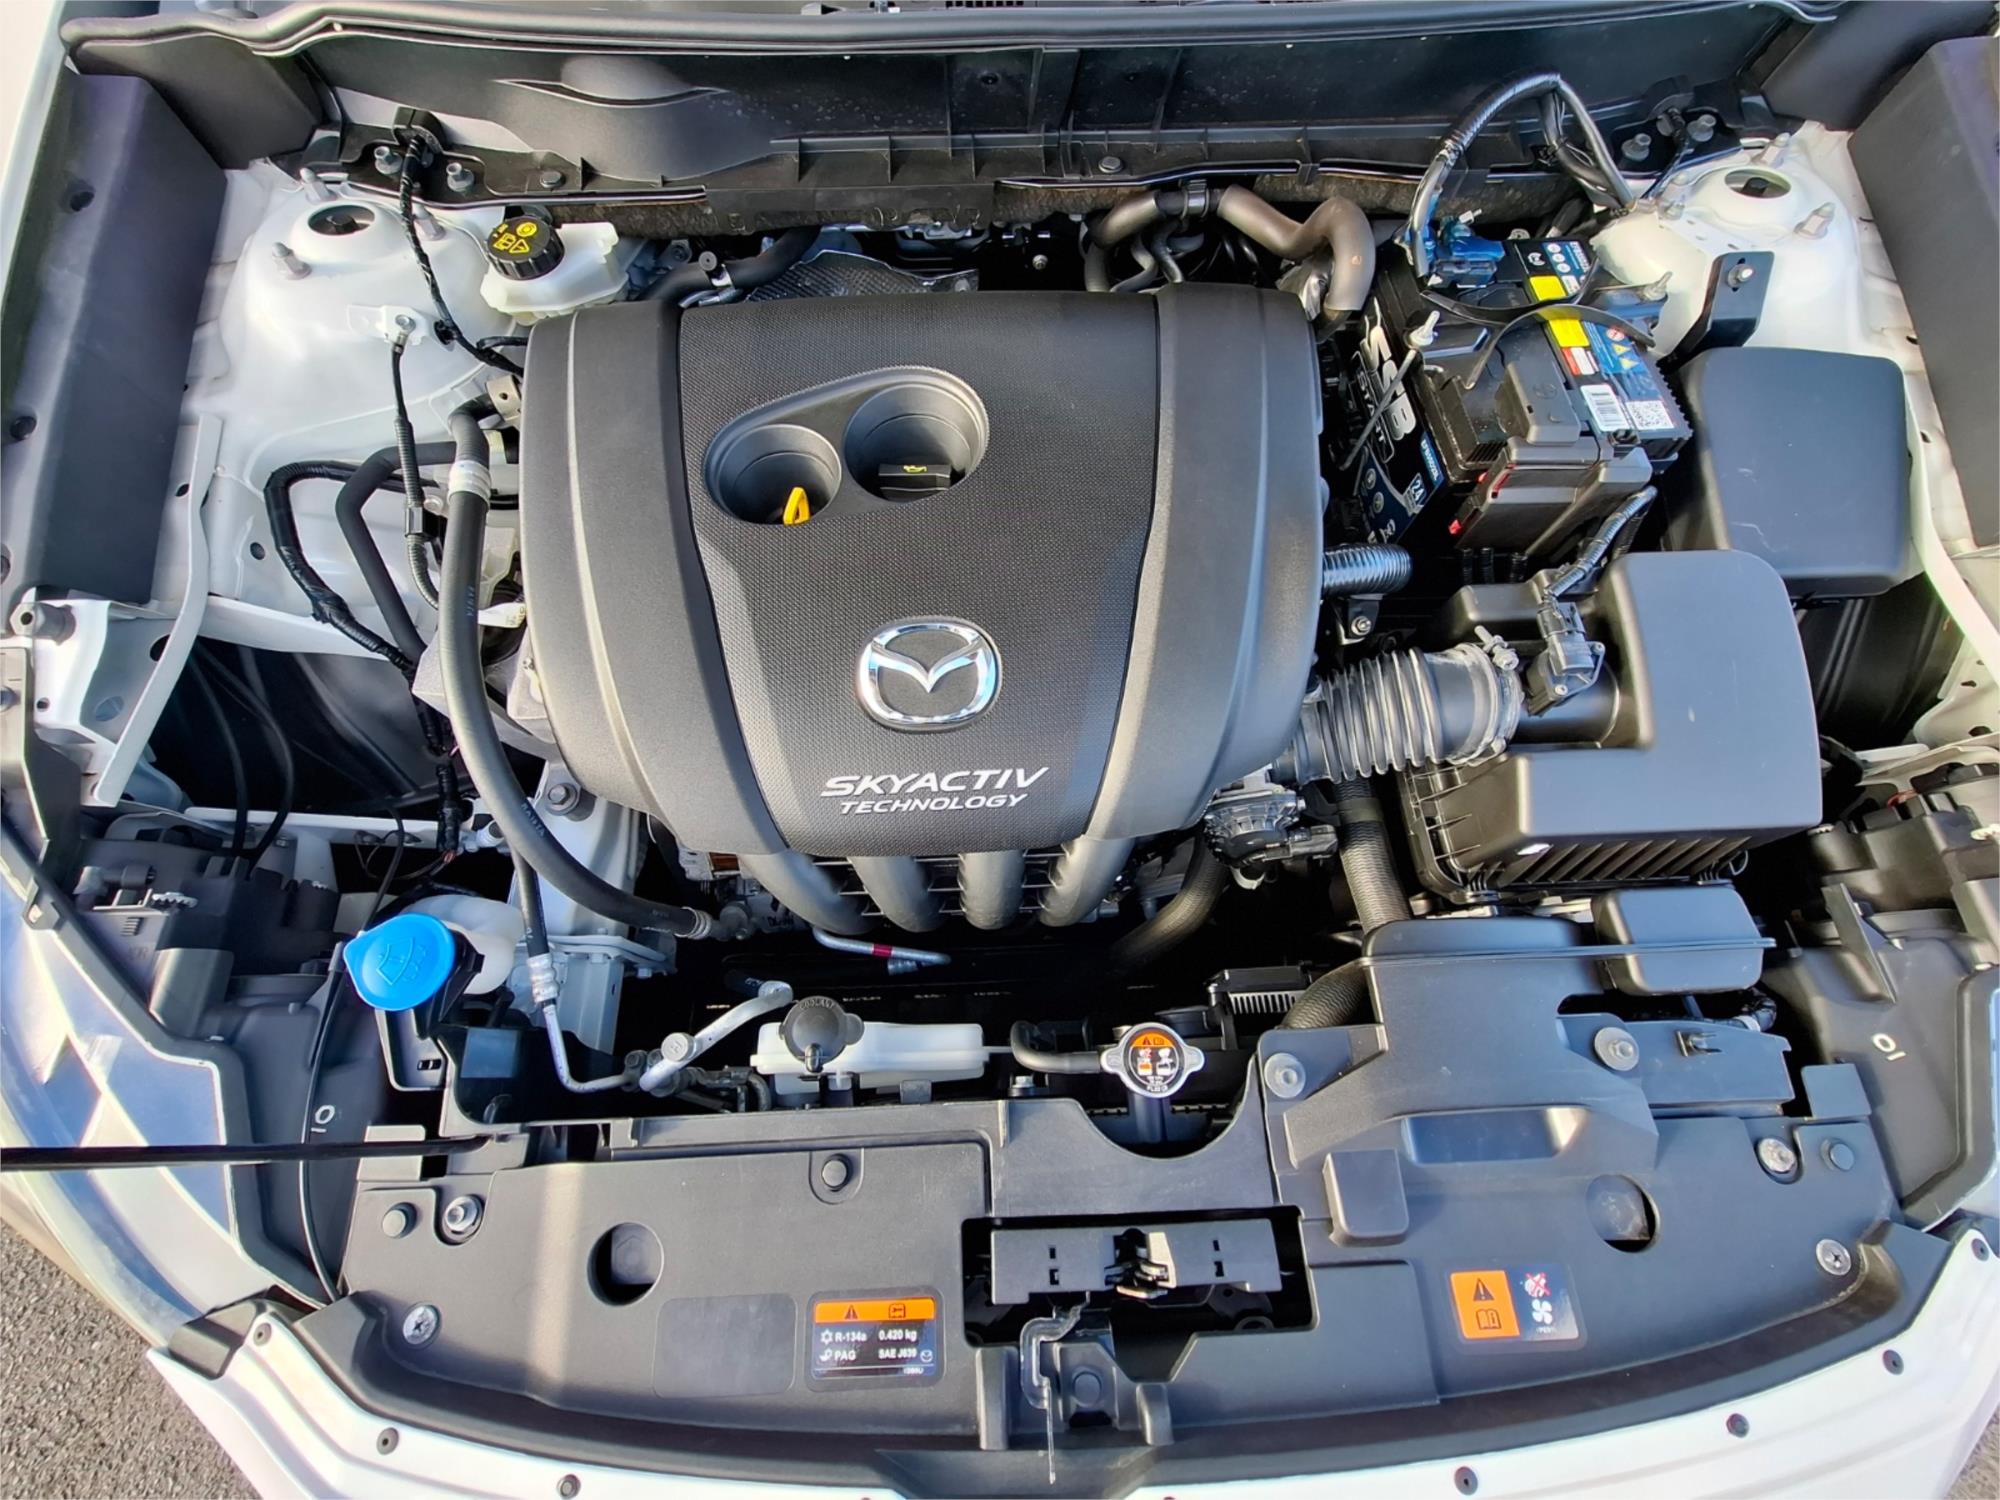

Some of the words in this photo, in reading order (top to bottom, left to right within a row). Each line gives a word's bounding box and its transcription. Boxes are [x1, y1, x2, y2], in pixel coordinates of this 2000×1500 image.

[820, 767, 1049, 797] SKYACTIV
[840, 794, 1028, 815] TECHNOLOGY
[834, 1331, 867, 1342] R-134a
[878, 1329, 904, 1342] 0.420
[904, 1329, 918, 1342] kg
[834, 1350, 857, 1361] PAG
